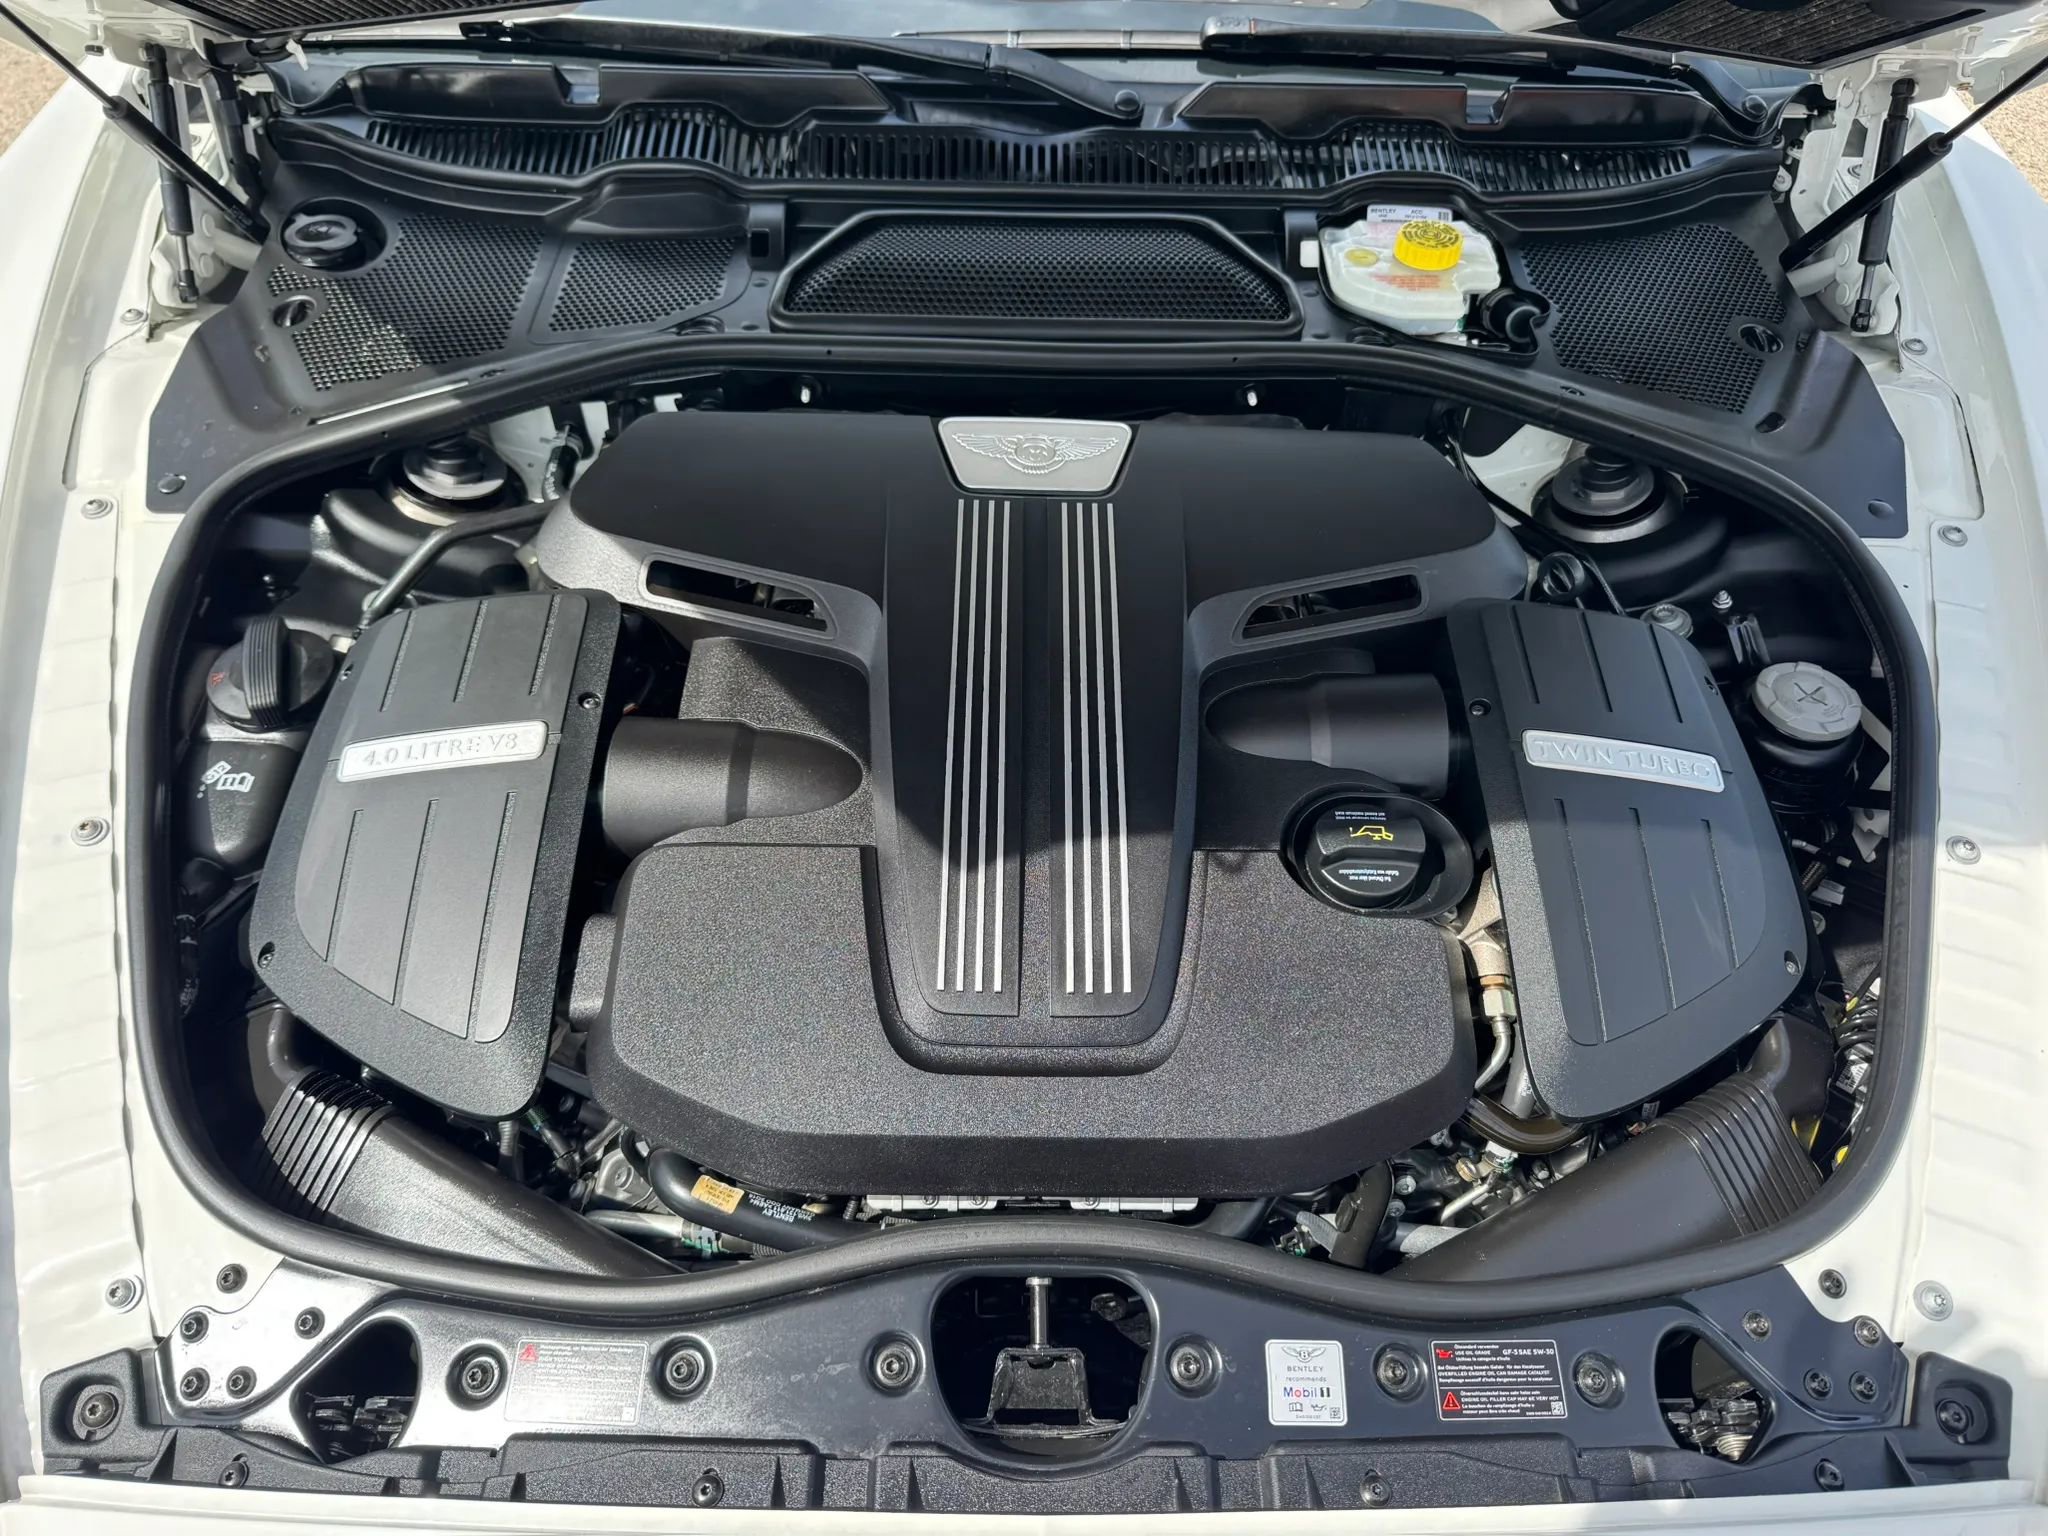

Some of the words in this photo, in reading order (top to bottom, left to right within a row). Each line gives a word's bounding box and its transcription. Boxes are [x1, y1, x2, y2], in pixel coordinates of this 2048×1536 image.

[364, 748, 399, 767] 4.0
[408, 737, 481, 760] LITRE
[490, 732, 519, 752] V8
[1535, 740, 1614, 765] TWIN
[1619, 749, 1711, 778] TURBO
[762, 1208, 795, 1222] BENTLEY
[1283, 1386, 1317, 1398] Mobil
